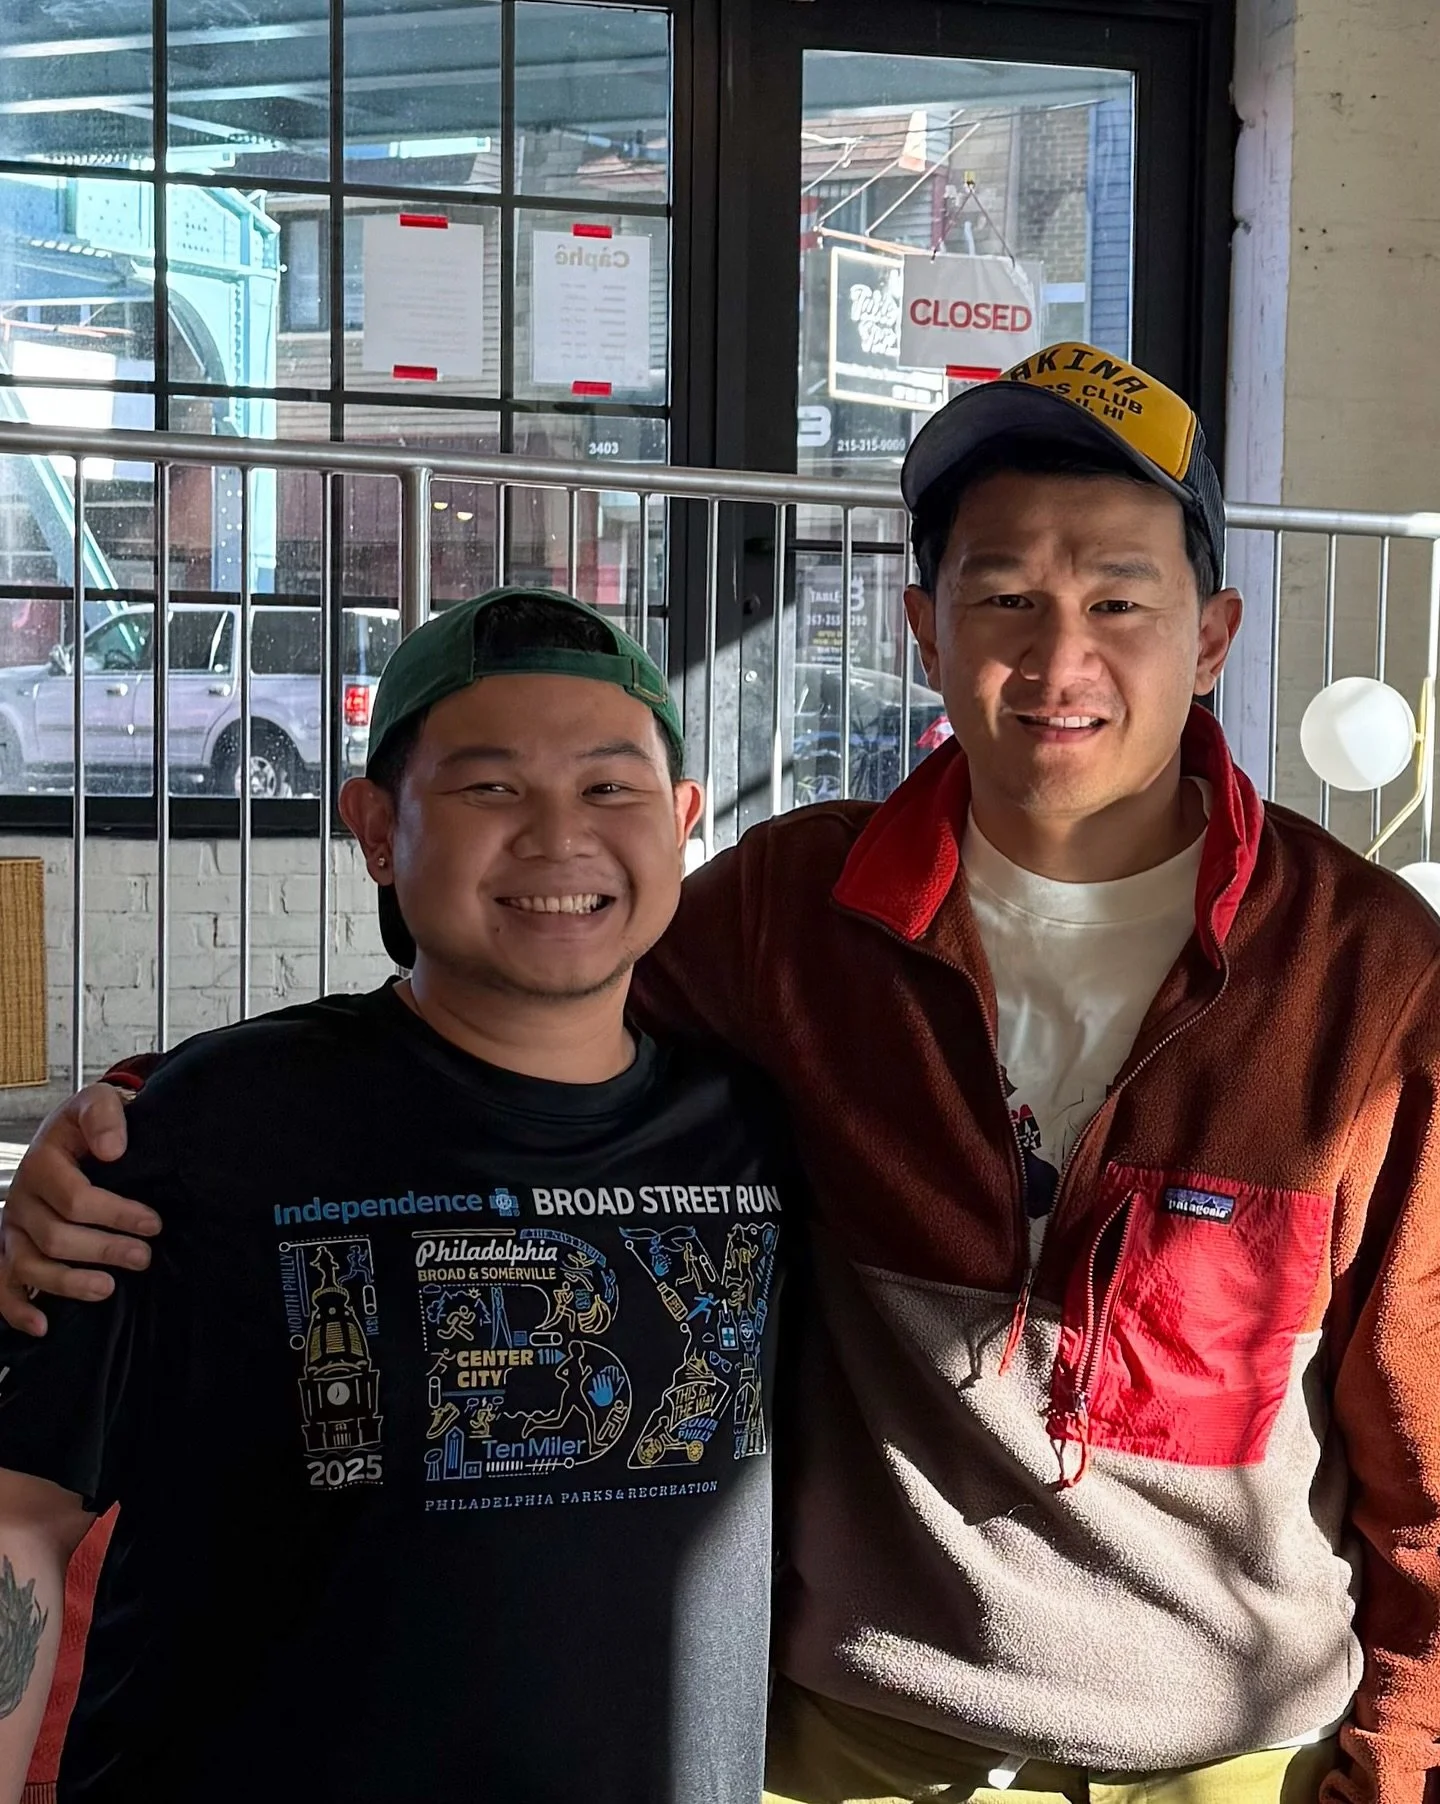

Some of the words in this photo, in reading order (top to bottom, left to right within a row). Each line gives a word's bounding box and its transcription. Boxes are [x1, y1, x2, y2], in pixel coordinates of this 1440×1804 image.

[909, 298, 1033, 333] CLOSED
[1010, 349, 1149, 394] AKINA
[1082, 385, 1143, 415] CLUB
[1104, 404, 1125, 421] HI
[588, 441, 620, 455] 3403
[274, 1190, 483, 1226] Independence
[532, 1187, 636, 1216] BROAD
[639, 1185, 732, 1214] STREET
[735, 1185, 782, 1214] RUN
[415, 1239, 557, 1267] Philadelphia
[279, 1252, 297, 1291] PHILLY
[417, 1269, 466, 1282] BROAD
[468, 1267, 479, 1280] &
[481, 1266, 558, 1280] SOMERVILLE
[457, 1349, 534, 1368] CENTER
[457, 1370, 502, 1388] CITY
[675, 1400, 695, 1422] THE
[695, 1392, 717, 1413] WAY
[676, 1384, 697, 1405] THIS
[698, 1384, 708, 1397] IS
[482, 1439, 525, 1459] Ten
[529, 1436, 587, 1457] Miler
[678, 1429, 713, 1442] PHILLY
[306, 1455, 383, 1486] 2025
[424, 1494, 554, 1512] PHILADELPHIA
